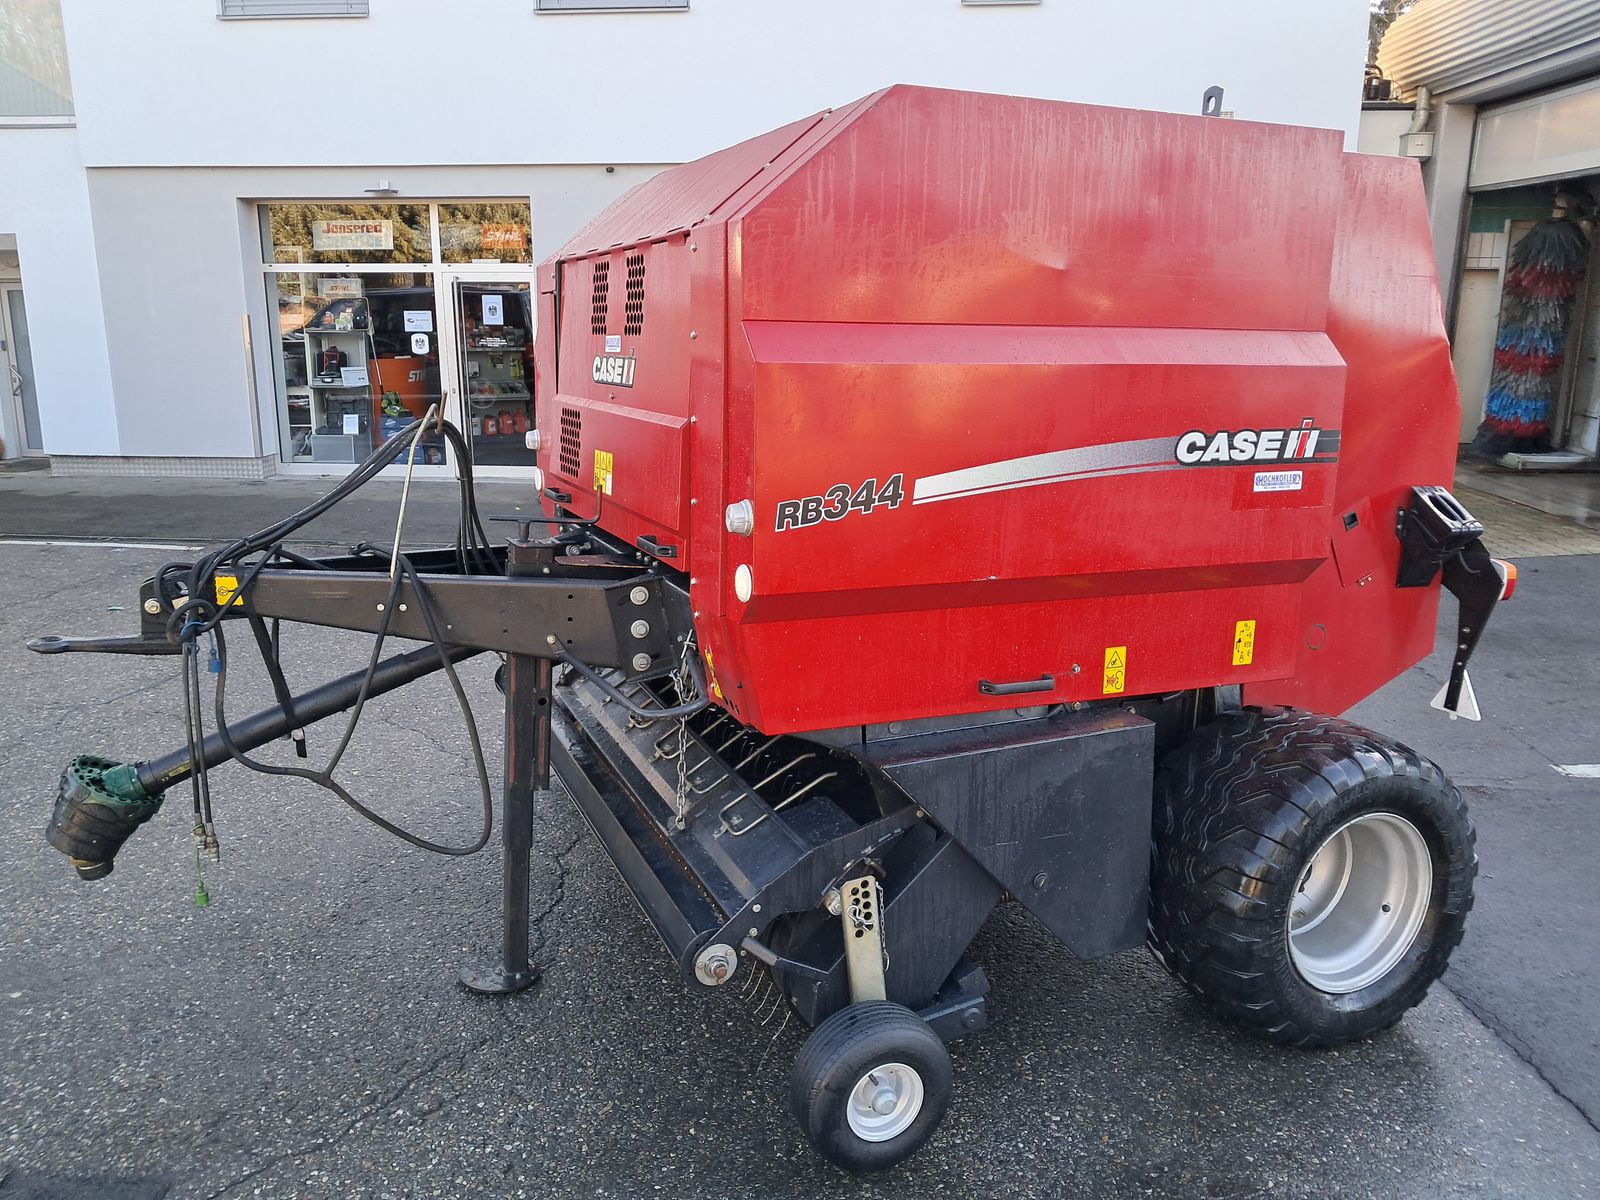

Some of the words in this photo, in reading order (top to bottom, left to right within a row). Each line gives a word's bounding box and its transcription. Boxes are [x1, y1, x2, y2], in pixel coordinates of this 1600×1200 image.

[592, 355, 624, 383] CASE
[1176, 430, 1285, 464] CASE
[775, 473, 904, 532] RB344
